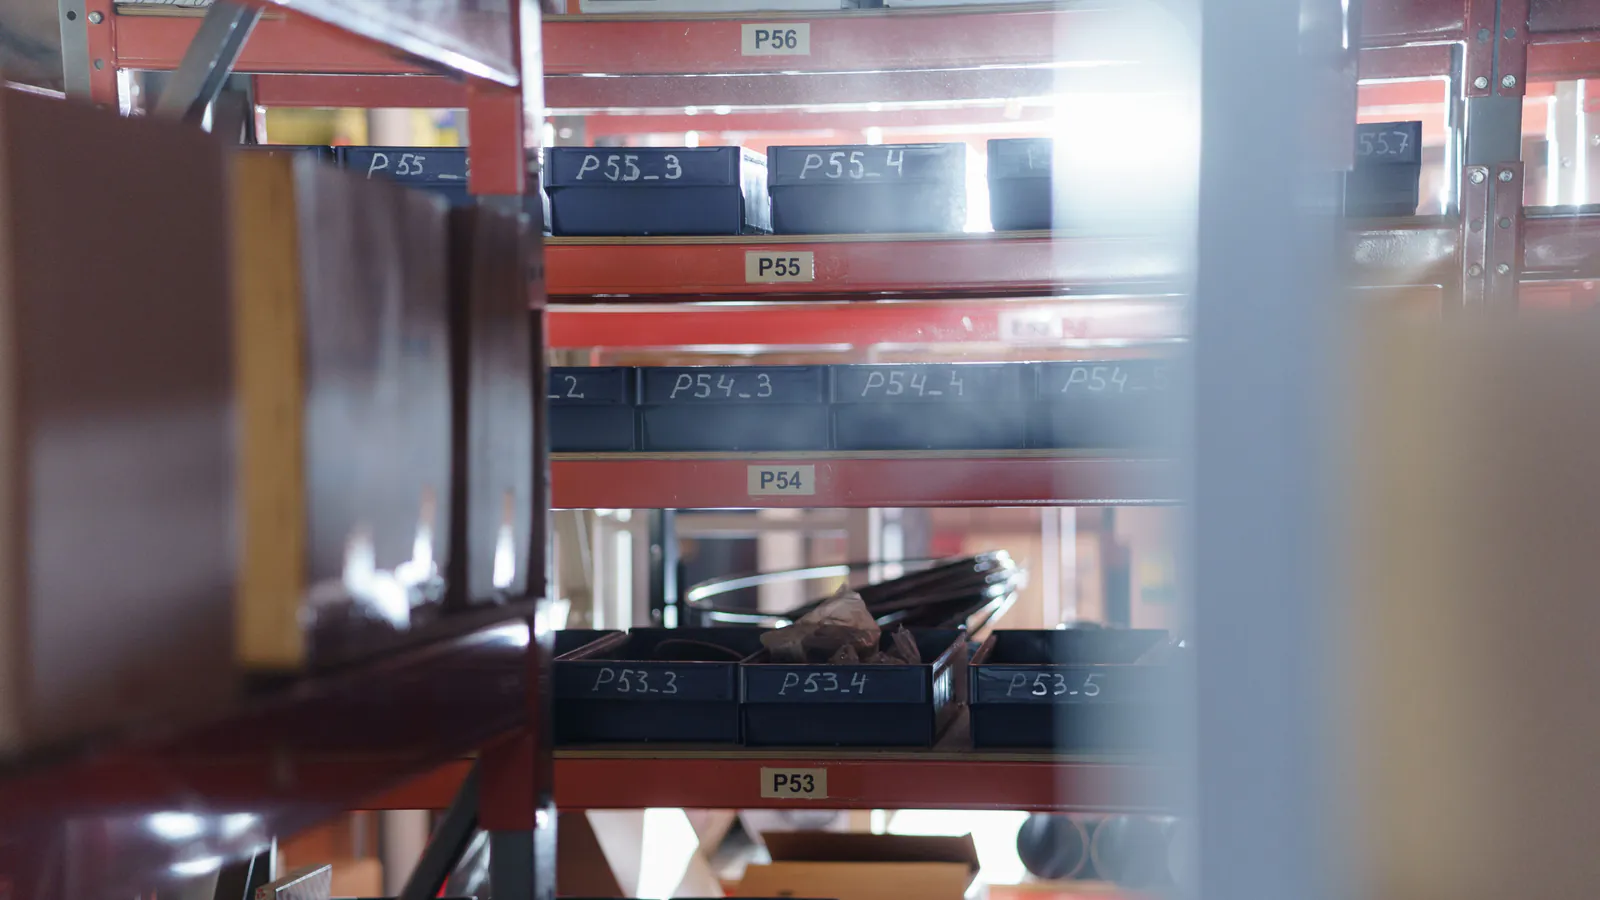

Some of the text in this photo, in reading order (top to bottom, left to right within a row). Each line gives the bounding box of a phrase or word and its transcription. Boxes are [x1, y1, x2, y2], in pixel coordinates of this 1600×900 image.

[755, 29, 797, 49] P56
[1359, 131, 1408, 155] 55_7
[576, 154, 682, 182] P55_3
[799, 149, 904, 179] P55_4
[758, 257, 801, 277] P55
[669, 373, 773, 399] P54_3
[861, 370, 964, 397] P54_4
[760, 470, 802, 490] P54
[773, 773, 815, 794] P53
